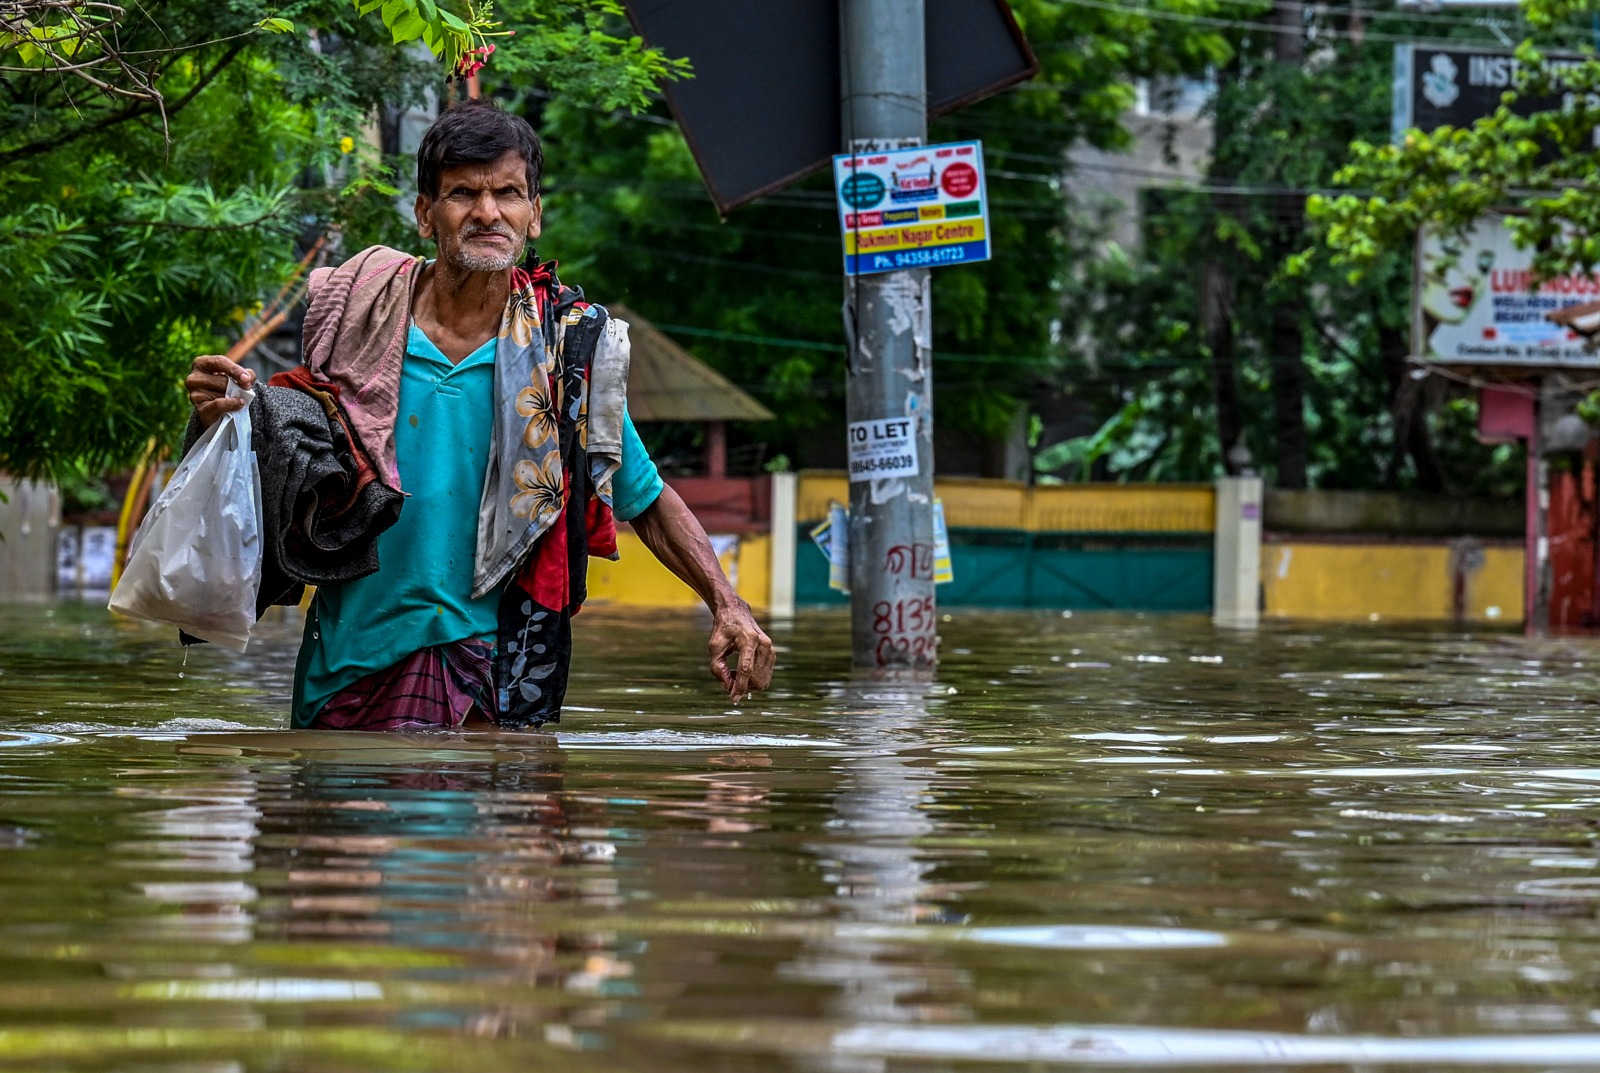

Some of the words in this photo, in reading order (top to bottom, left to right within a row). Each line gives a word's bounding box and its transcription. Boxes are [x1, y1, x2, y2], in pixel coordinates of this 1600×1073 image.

[857, 230, 899, 249] Rukmini
[902, 228, 934, 247] Nagar
[935, 224, 974, 241] Centre
[850, 427, 867, 443] TO
[873, 421, 910, 440] LET
